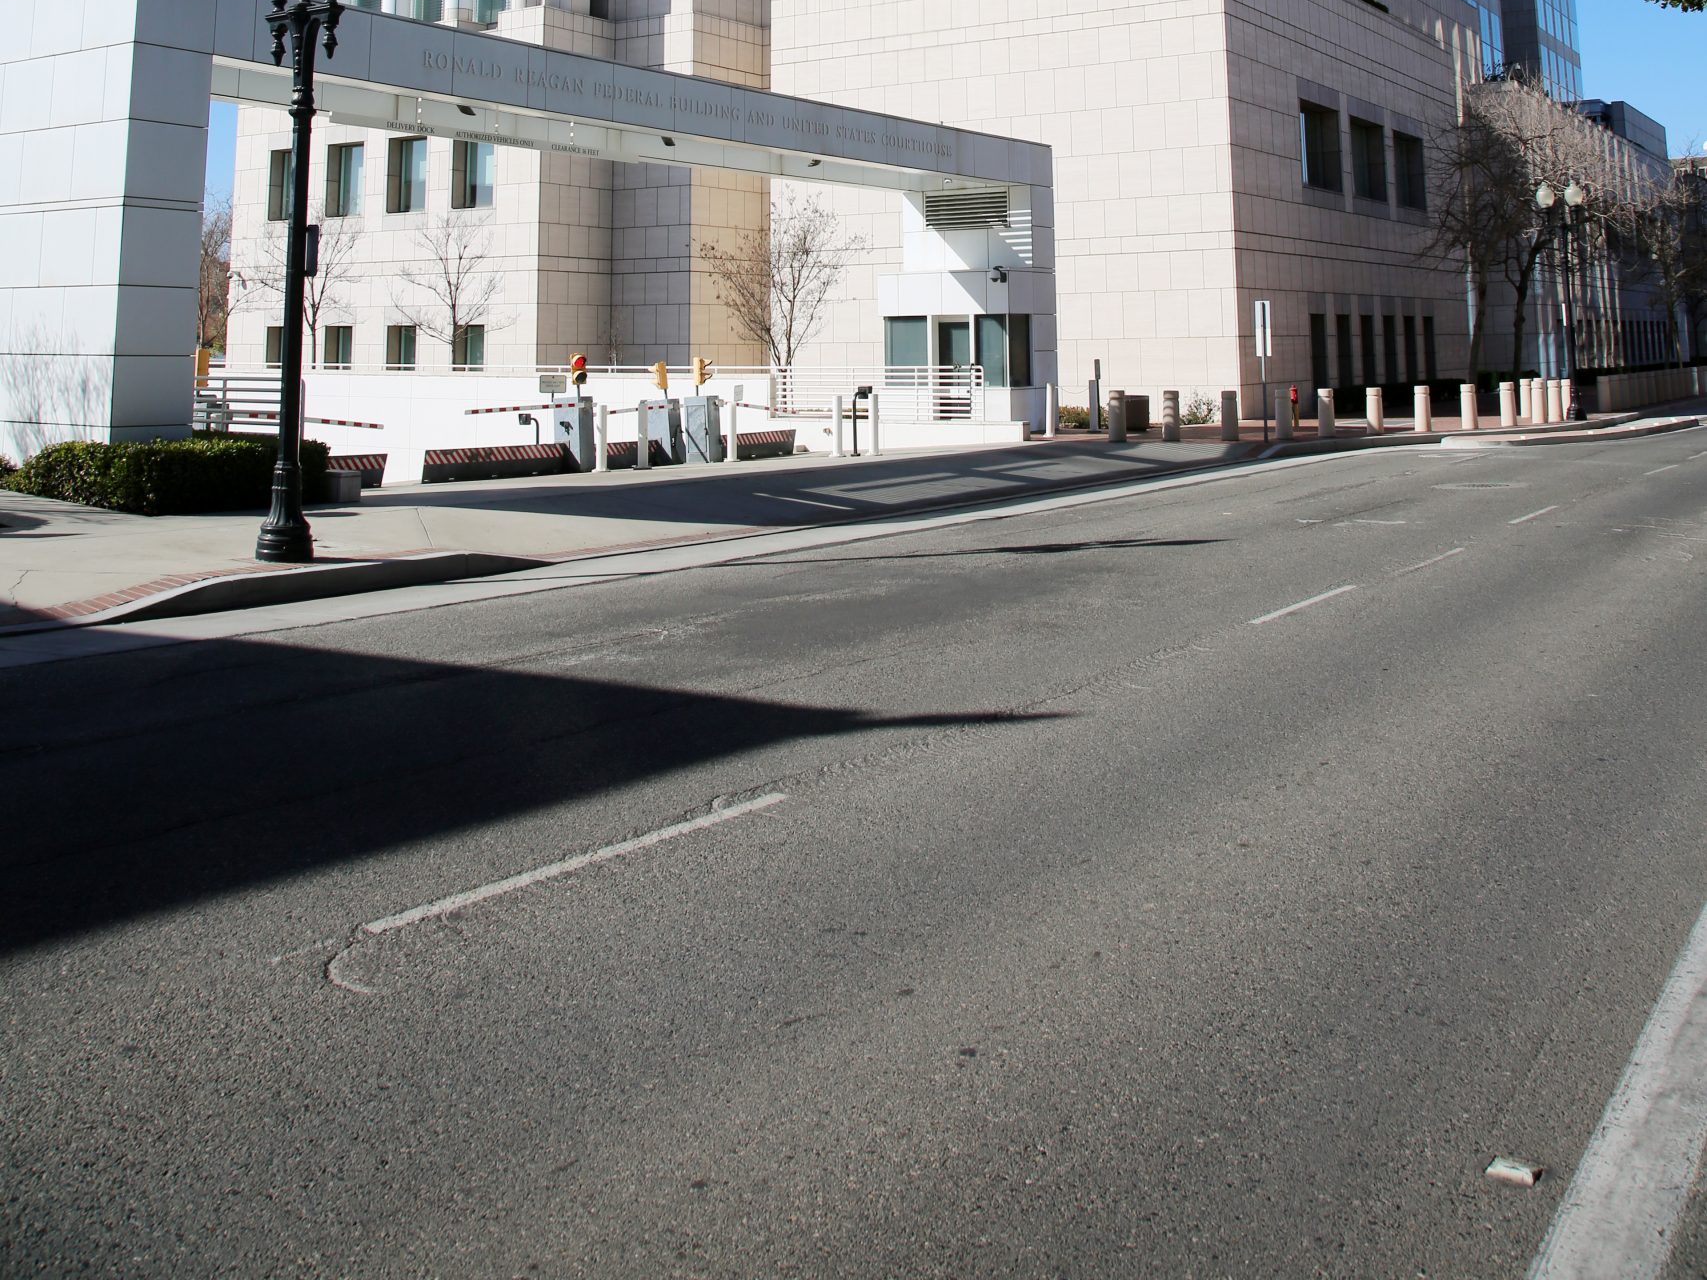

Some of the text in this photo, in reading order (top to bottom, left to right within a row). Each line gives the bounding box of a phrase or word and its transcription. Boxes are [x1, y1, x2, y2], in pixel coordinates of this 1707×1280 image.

[423, 50, 953, 158] RONALD REAGAN FEDERAL BUILDING AND UNITED STATES COURTHOUSE
[386, 121, 435, 134] DELIVERY DOCK
[455, 131, 535, 148] AUTHORIZED VEHICLES ONLY
[551, 144, 581, 154] CLEARANCE
[587, 148, 600, 157] FEET
